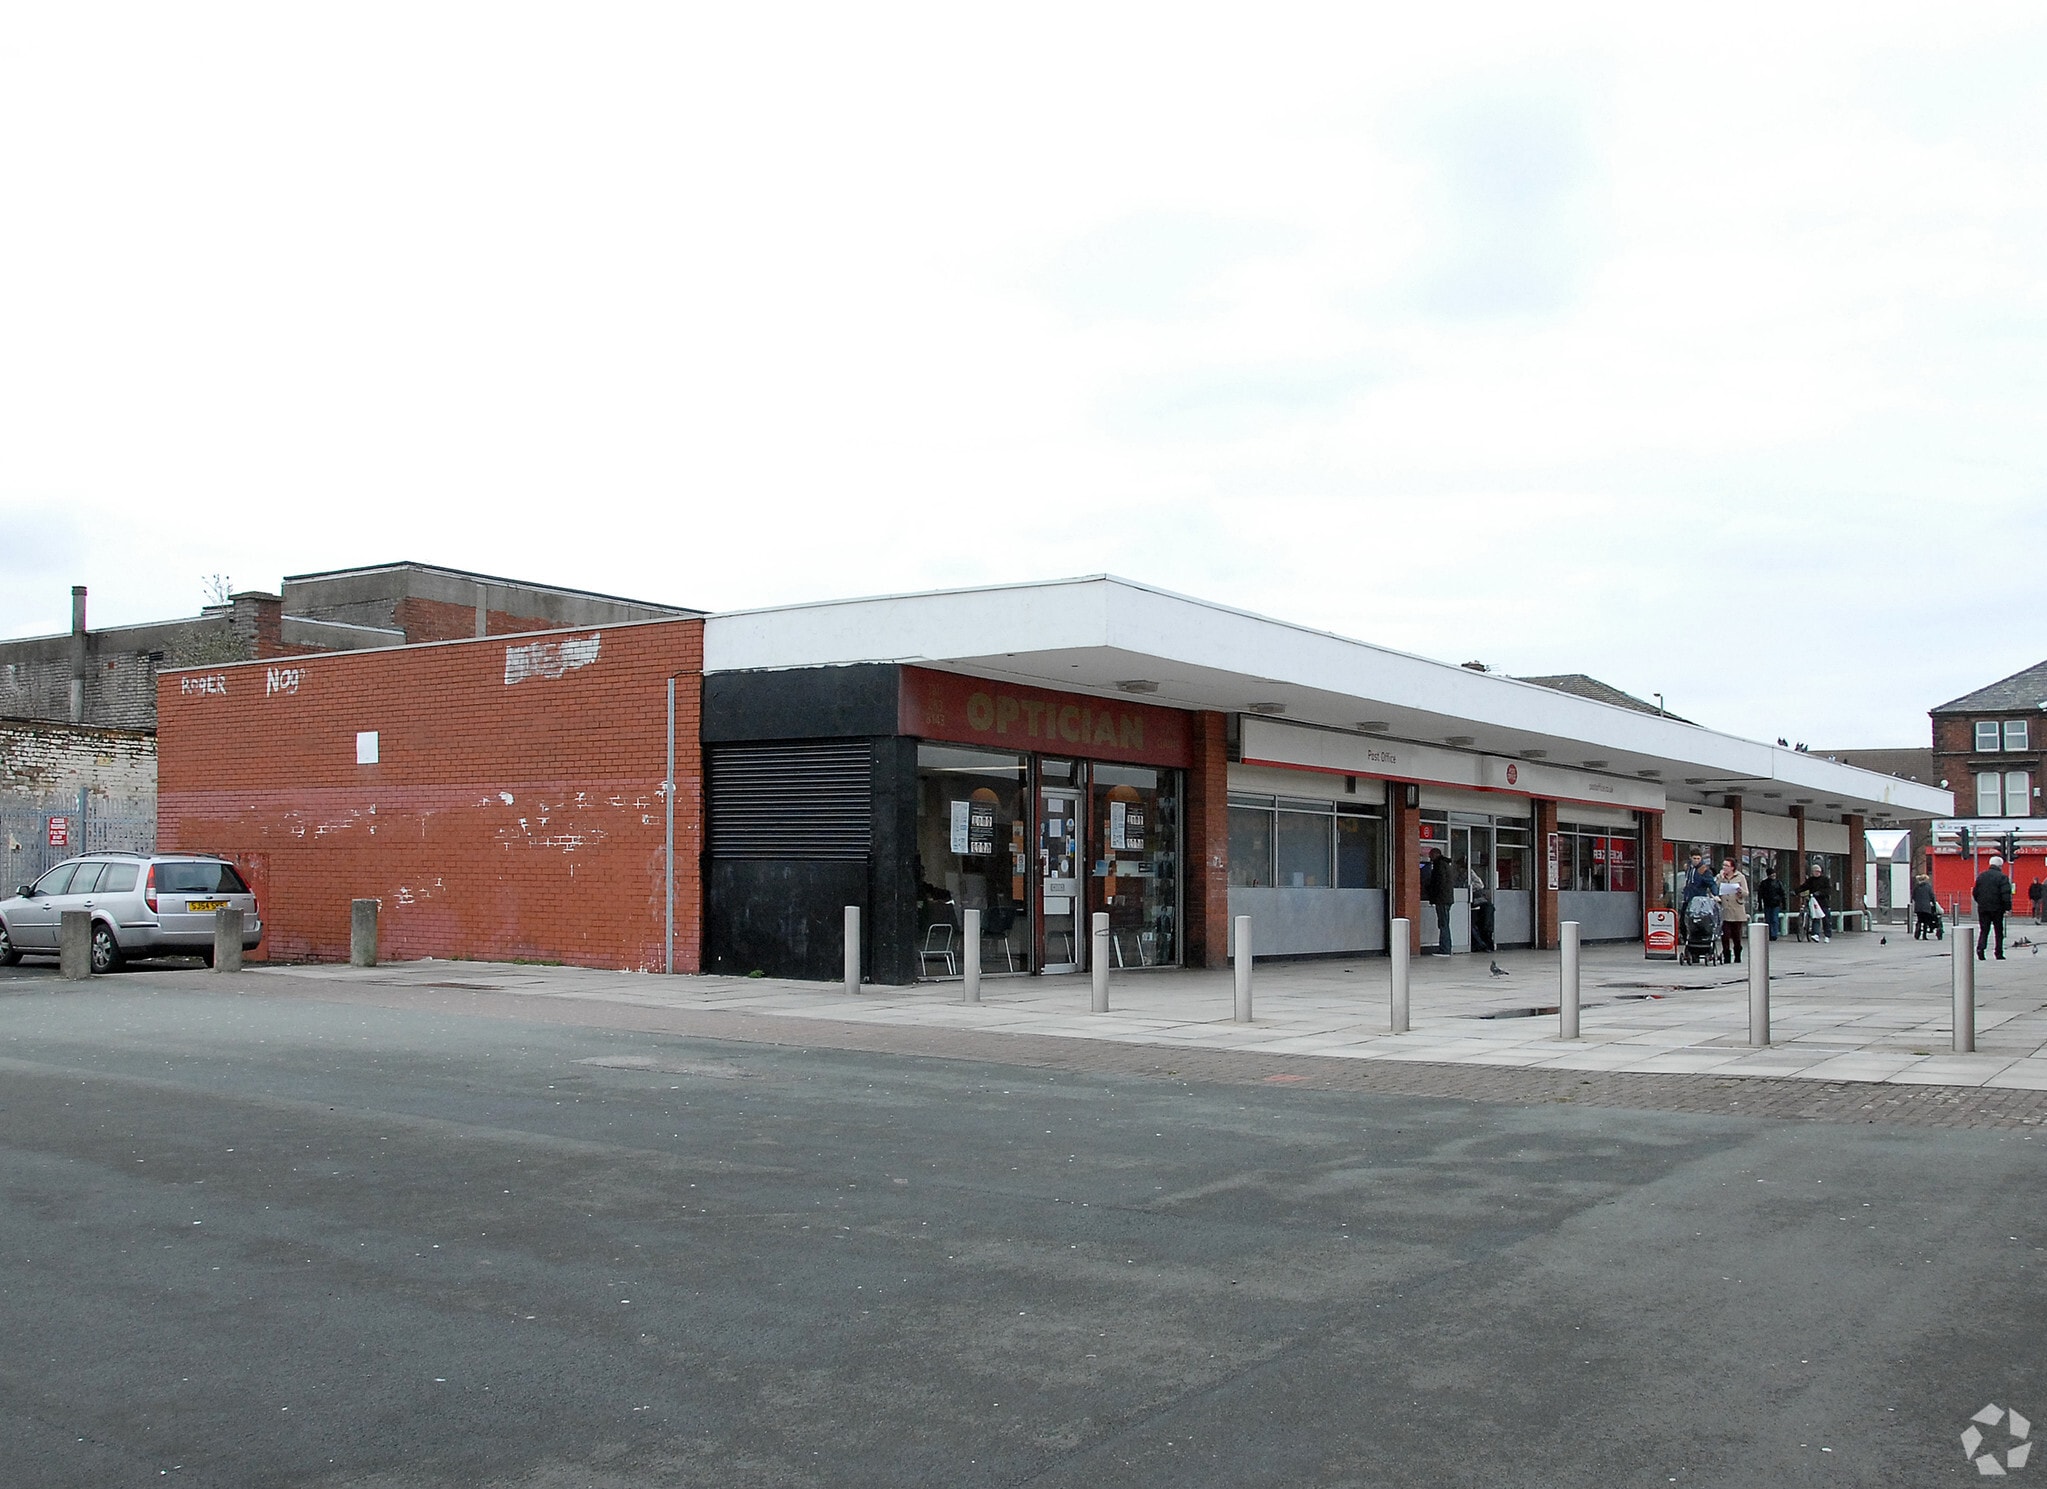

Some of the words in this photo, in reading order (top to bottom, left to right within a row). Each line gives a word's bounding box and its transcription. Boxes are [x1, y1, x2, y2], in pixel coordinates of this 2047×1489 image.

[966, 692, 1144, 750] OPTICIAN
[1368, 749, 1380, 761] Post
[1381, 751, 1396, 764] Office
